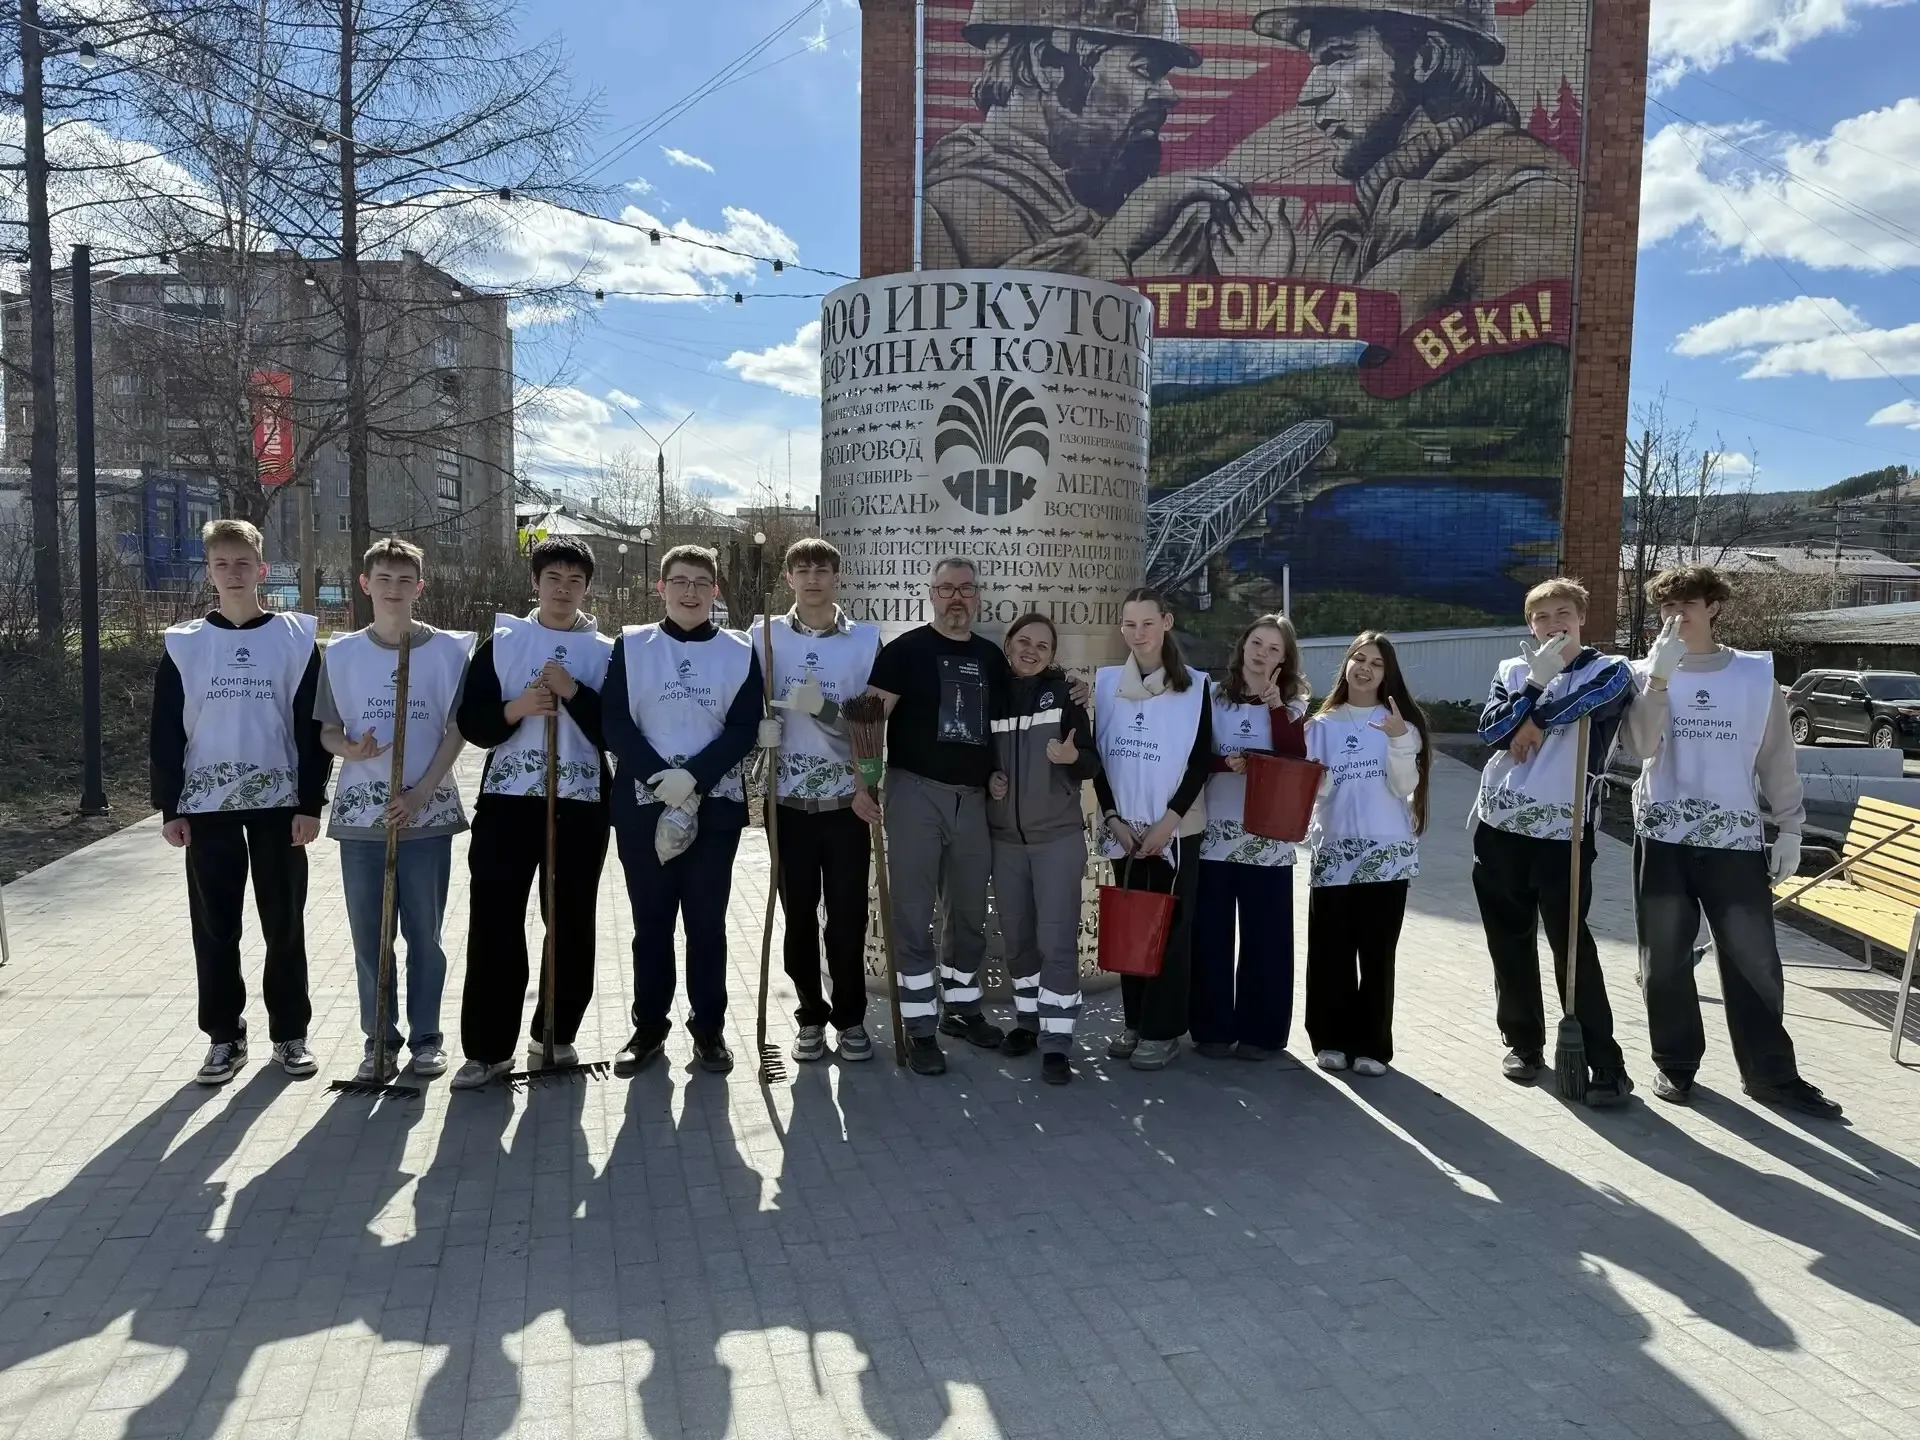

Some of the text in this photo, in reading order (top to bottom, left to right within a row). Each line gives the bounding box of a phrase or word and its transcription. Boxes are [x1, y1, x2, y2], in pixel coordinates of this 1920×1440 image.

[1140, 282, 1552, 370] ТРОЙКА ВЕКА!
[822, 337, 978, 390] ЕФТЯНАЯ
[875, 398, 934, 414] ОТРАСЛЬ
[857, 469, 913, 485] СИБИРЬ
[942, 469, 1037, 516] ИНК
[851, 493, 940, 517] ОКЕАН»
[870, 540, 1020, 556] ЛОГИСТИЧЕСКАЯ
[1026, 542, 1111, 562] ОПЕРАЦИЯ
[902, 559, 932, 576] ПО
[975, 560, 1063, 578] ЕРНОМУ
[839, 591, 1122, 625] ТСКИЙ ВОД ПОЛИ
[211, 676, 272, 688] Компания
[664, 680, 711, 696] Комания
[206, 687, 276, 701] добрых дел
[658, 689, 692, 703] добры
[367, 697, 426, 709] Комния
[411, 711, 430, 721] дел
[1673, 716, 1732, 729] Компания
[1715, 731, 1738, 741] дел
[1142, 751, 1161, 763] дел
